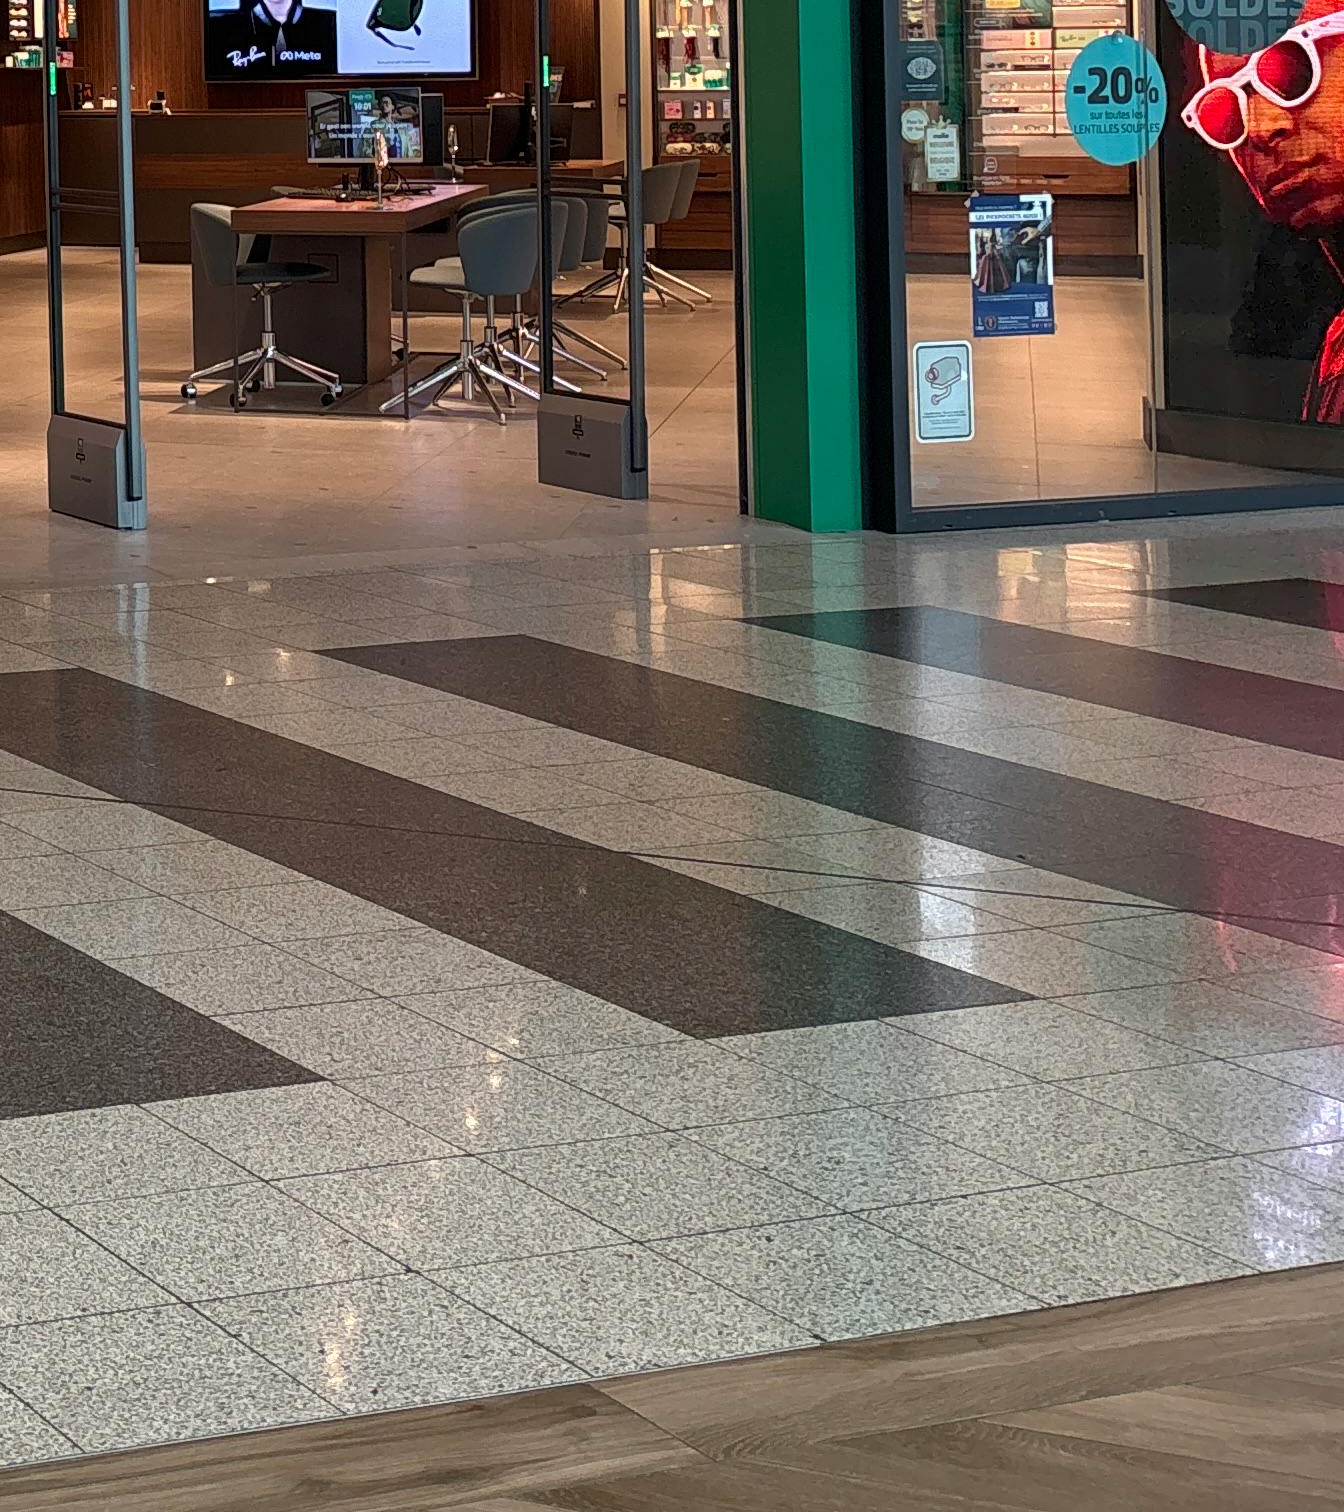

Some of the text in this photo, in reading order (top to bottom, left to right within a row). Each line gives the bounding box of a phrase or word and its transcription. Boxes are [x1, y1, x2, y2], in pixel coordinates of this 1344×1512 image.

[294, 51, 322, 61] Meta
[1073, 66, 1159, 105] -20%
[1089, 111, 1103, 120] sur
[1105, 110, 1131, 120] toutes
[1074, 123, 1120, 134] LENTILLES
